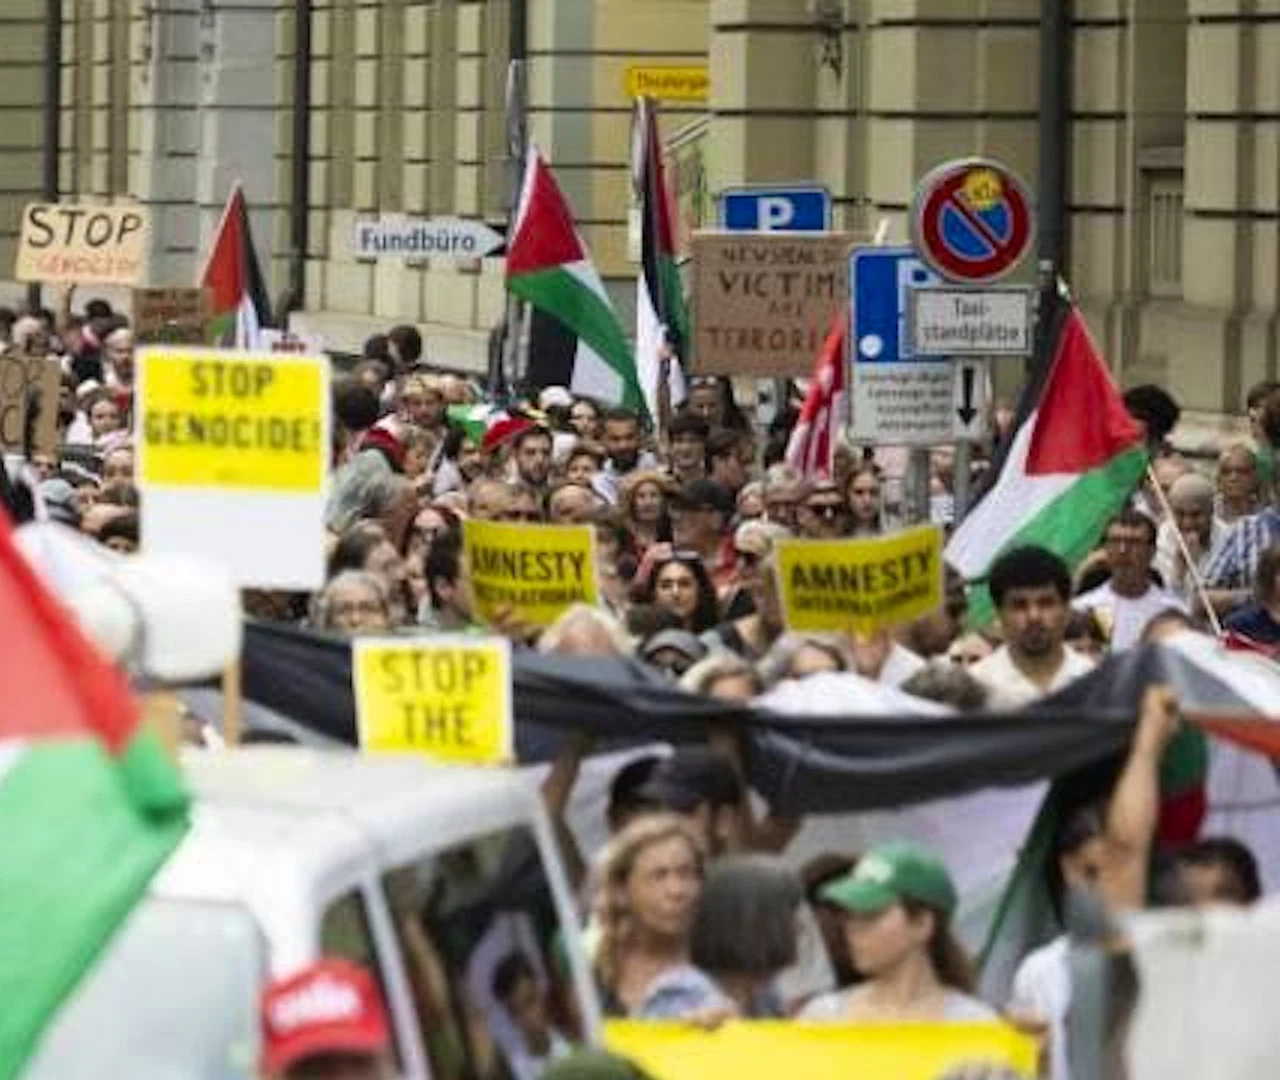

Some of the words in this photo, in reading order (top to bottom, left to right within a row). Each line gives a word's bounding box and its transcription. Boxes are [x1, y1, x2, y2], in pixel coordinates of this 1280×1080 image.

[28, 207, 141, 248] STOP
[757, 197, 795, 231] P
[361, 228, 476, 252] Fundbüro
[954, 298, 992, 317] Taxi-
[705, 327, 817, 352] TERRORI
[923, 325, 1020, 344] standplätze
[192, 362, 273, 398] STOP
[471, 545, 585, 581] AMNESTY
[792, 547, 933, 592] AMNESTY
[379, 653, 487, 694] STOP
[400, 703, 474, 746] THE
